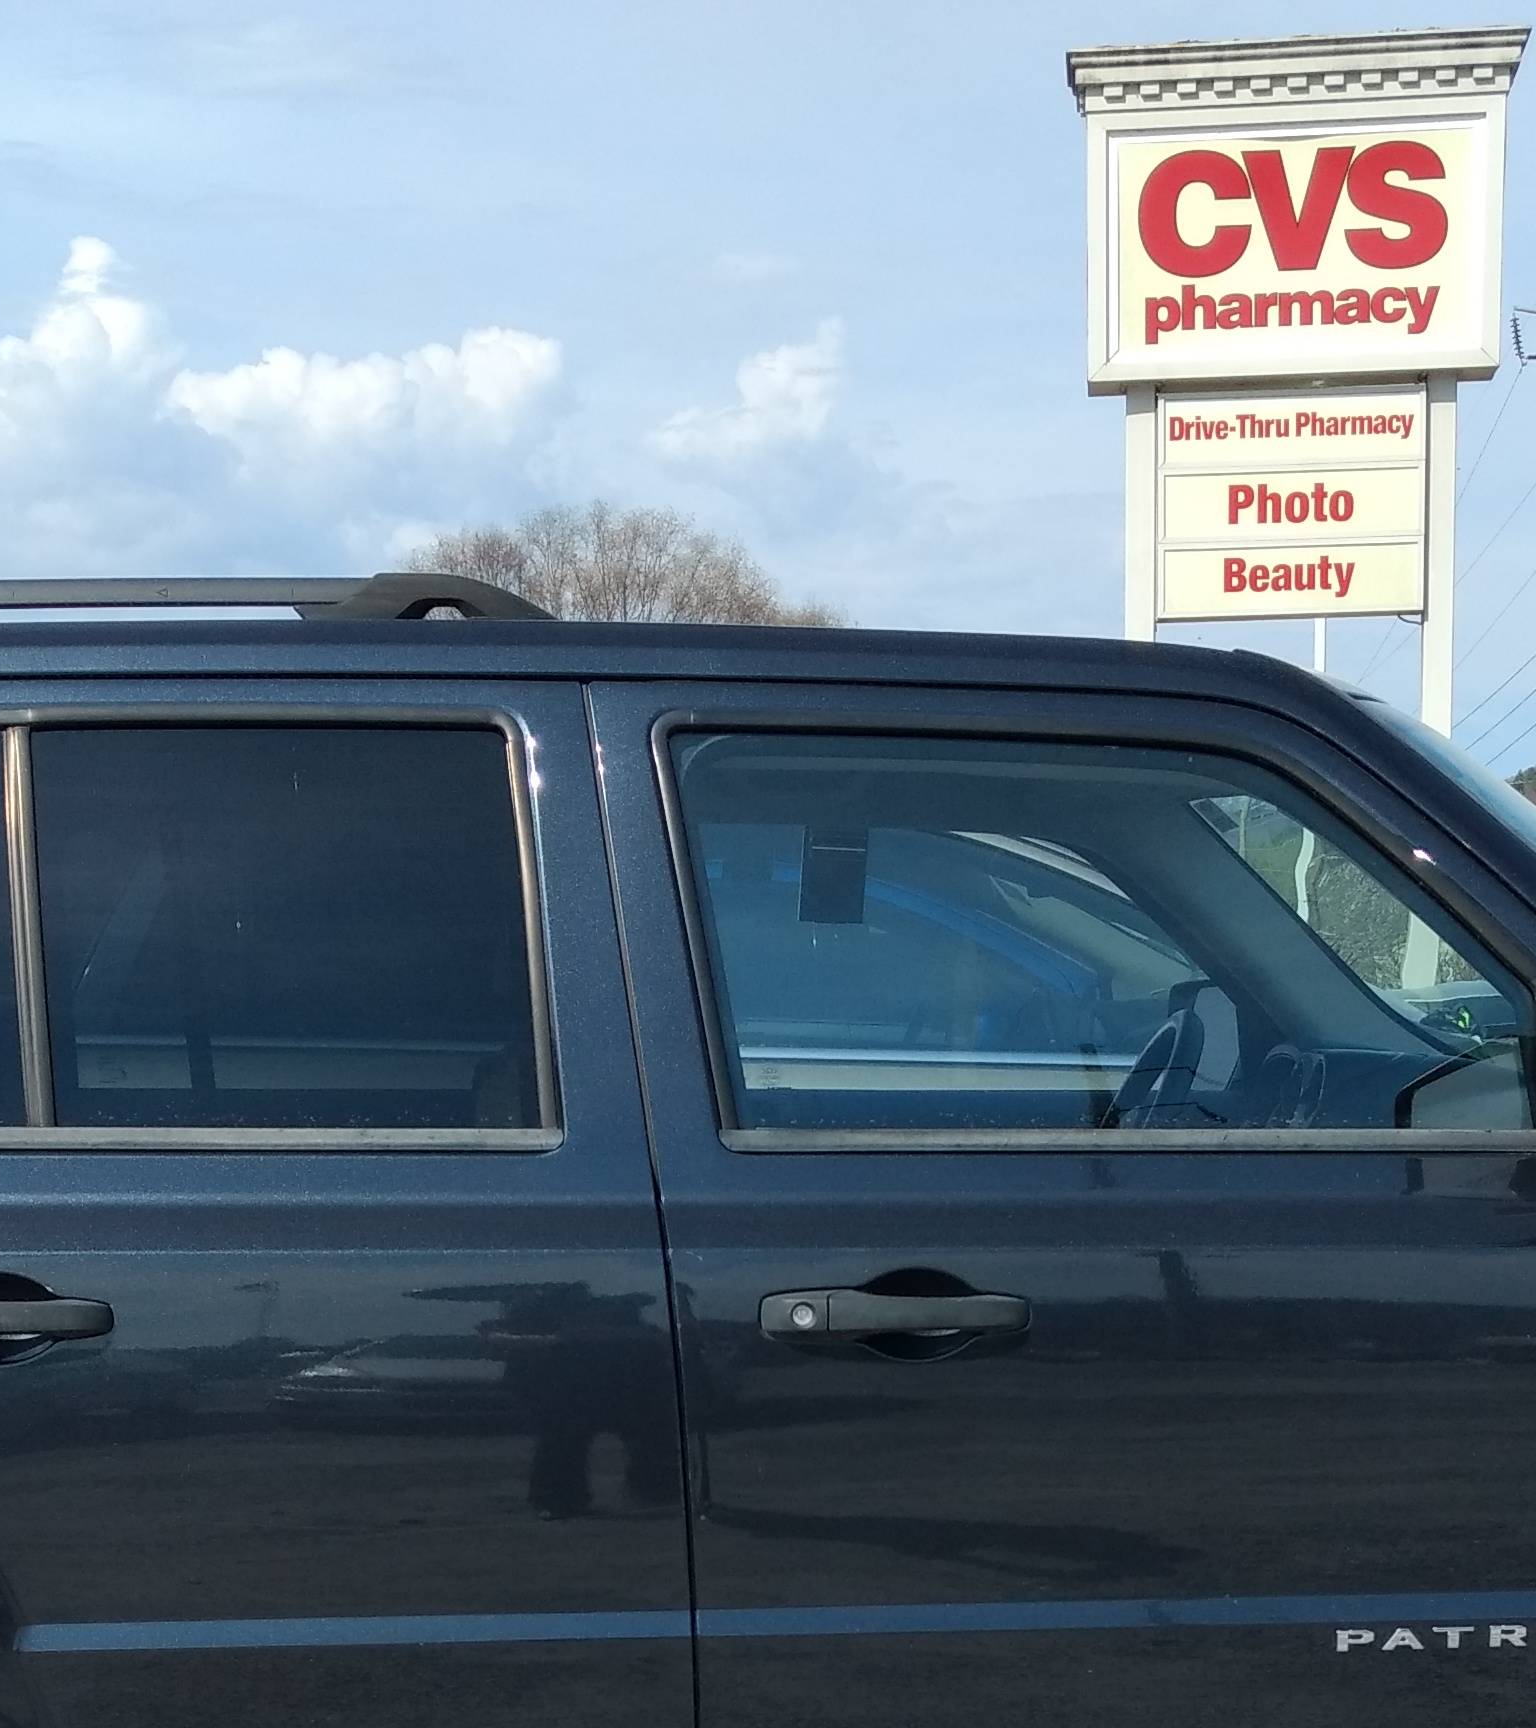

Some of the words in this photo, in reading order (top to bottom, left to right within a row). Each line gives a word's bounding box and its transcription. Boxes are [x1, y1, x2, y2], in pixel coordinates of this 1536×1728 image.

[1138, 140, 1448, 278] CVS
[1145, 285, 1441, 345] pharmacy
[1169, 414, 1290, 441] Drive-Thru
[1295, 412, 1415, 439] Pharmacy
[1228, 482, 1354, 525] Photo
[1223, 555, 1355, 597] Beauty
